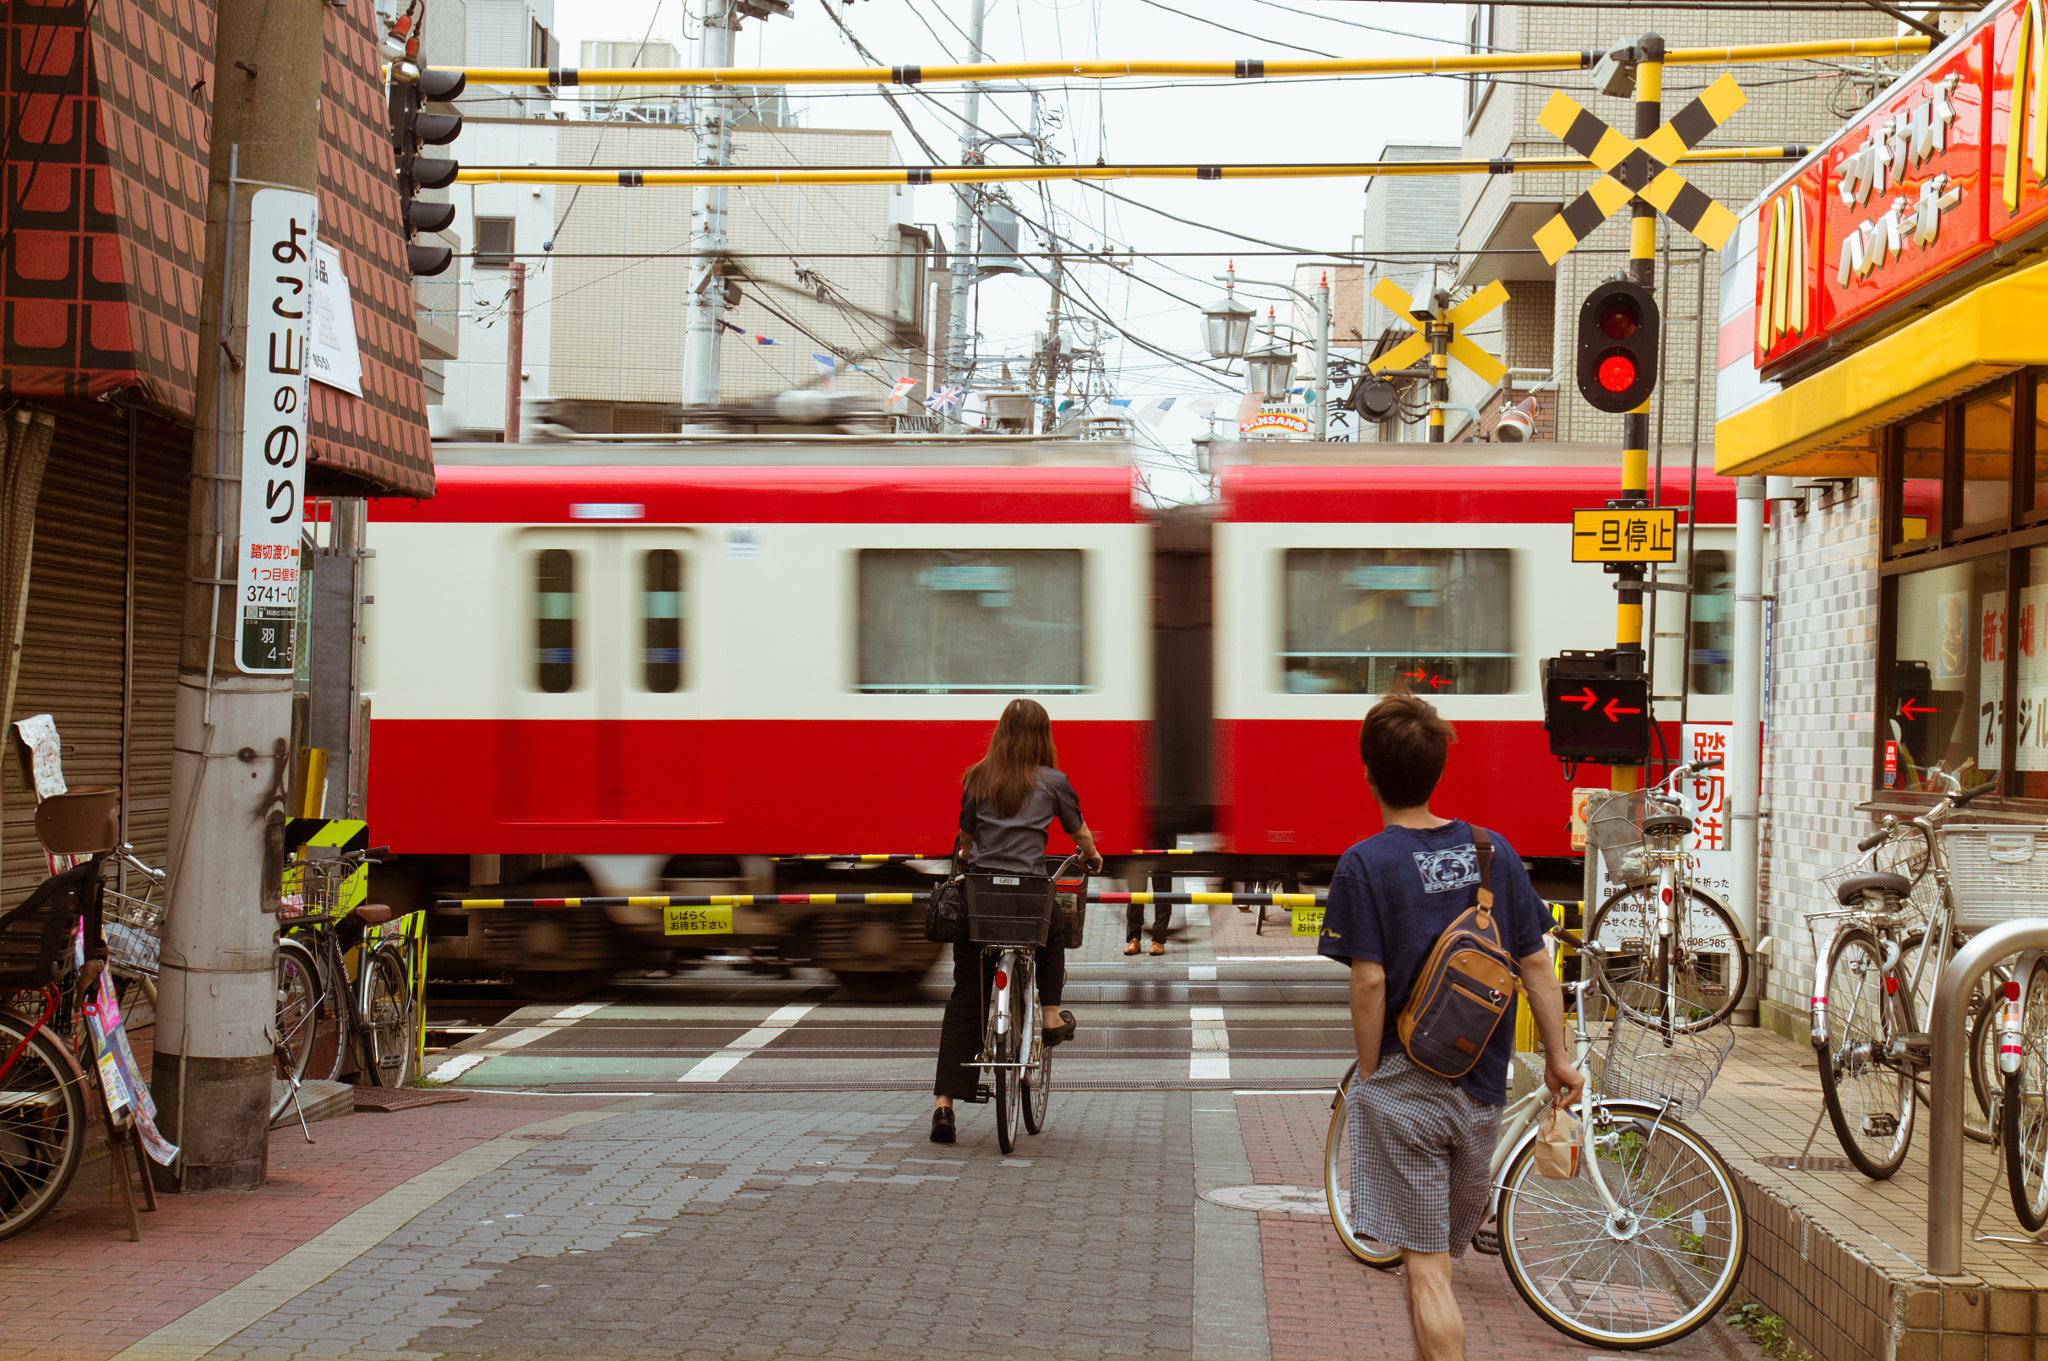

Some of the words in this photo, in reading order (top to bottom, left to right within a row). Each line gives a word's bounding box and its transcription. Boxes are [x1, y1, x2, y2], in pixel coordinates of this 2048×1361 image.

[1835, 70, 1959, 210] マクドナルド
[1837, 171, 1962, 288] ハンバーガー
[264, 217, 307, 524] よこ山ののり
[250, 543, 290, 560] 踏切渡り
[1575, 518, 1672, 552] 一旦停止
[670, 910, 707, 921] しばらく
[670, 920, 728, 931] お待ち下さい
